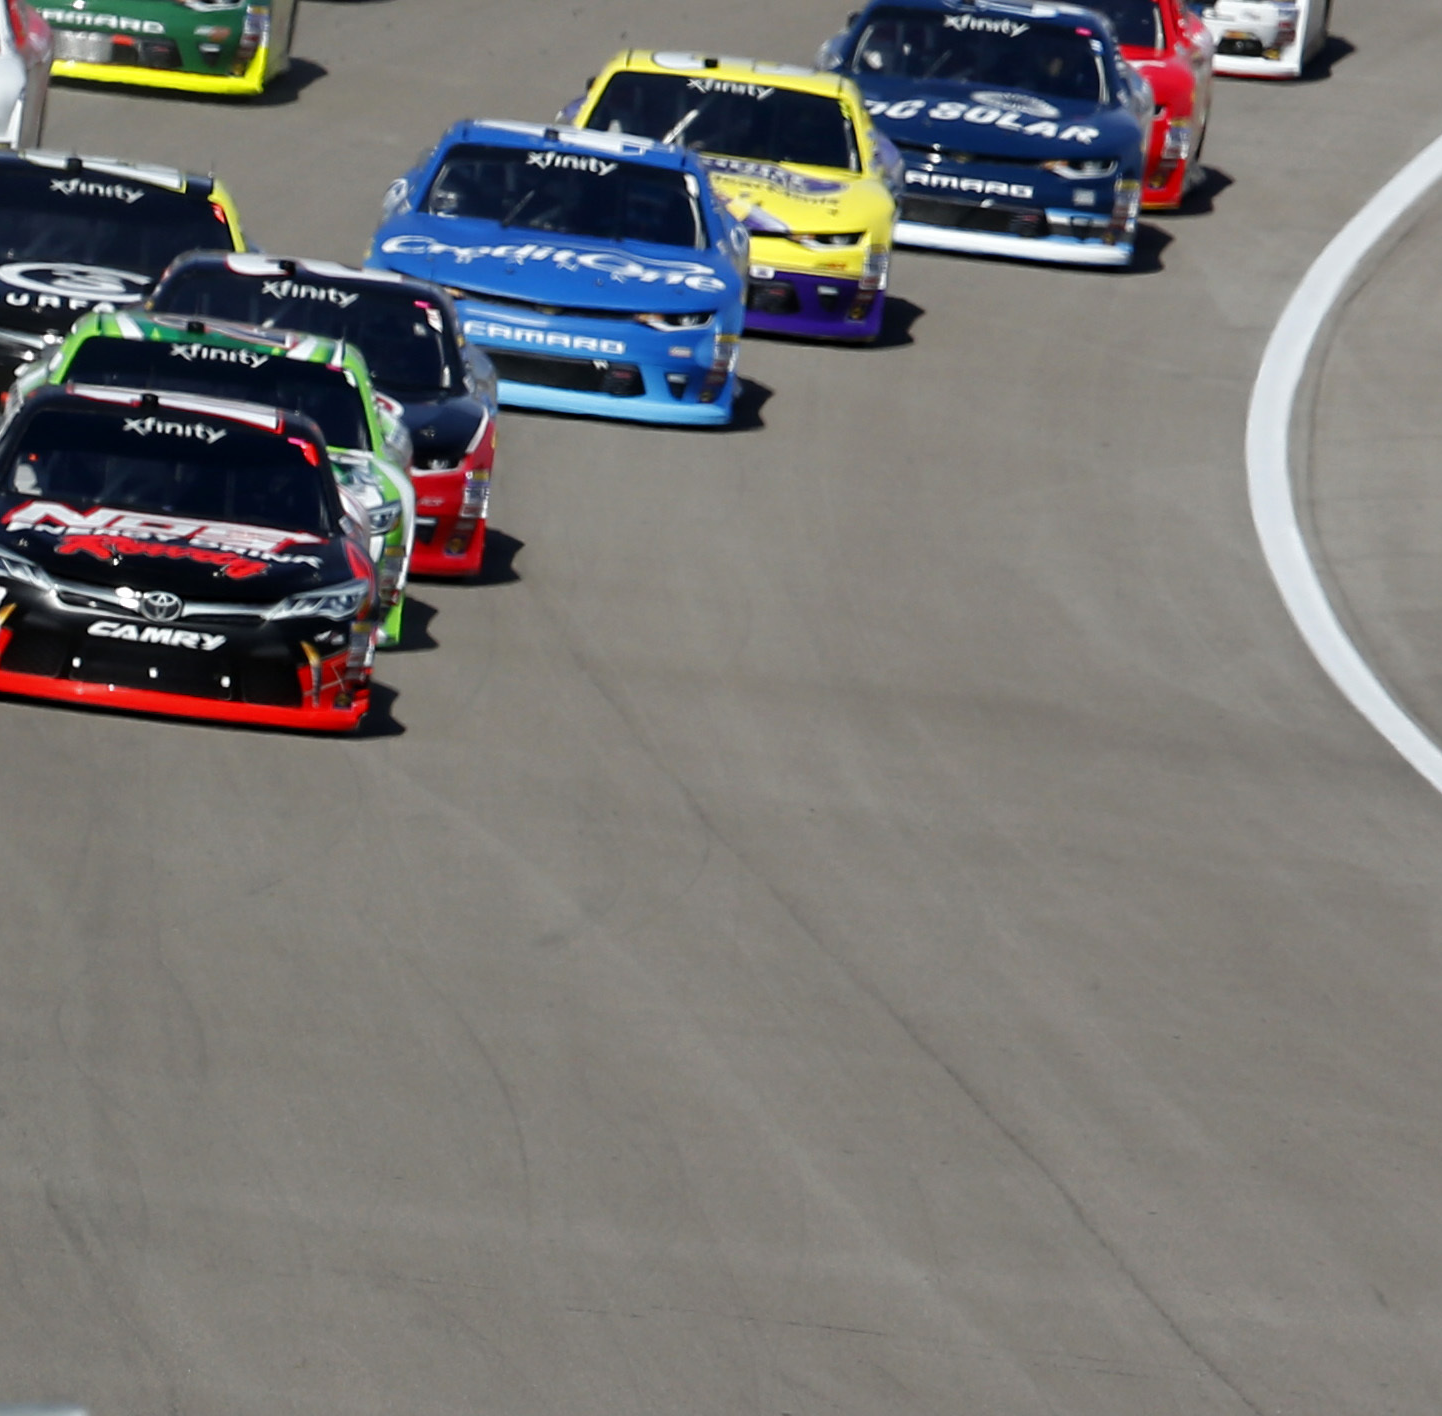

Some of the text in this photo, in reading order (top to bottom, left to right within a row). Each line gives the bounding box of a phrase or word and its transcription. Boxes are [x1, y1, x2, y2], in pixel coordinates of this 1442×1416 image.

[928, 101, 1100, 145] SOLAR
[526, 150, 618, 176] xfinity
[50, 177, 145, 204] xfinity
[262, 280, 359, 307] xfinity
[464, 320, 627, 356] CAMARO
[171, 343, 268, 369] xfinity
[123, 416, 227, 444] xfinity
[87, 620, 228, 652] CAMRY
